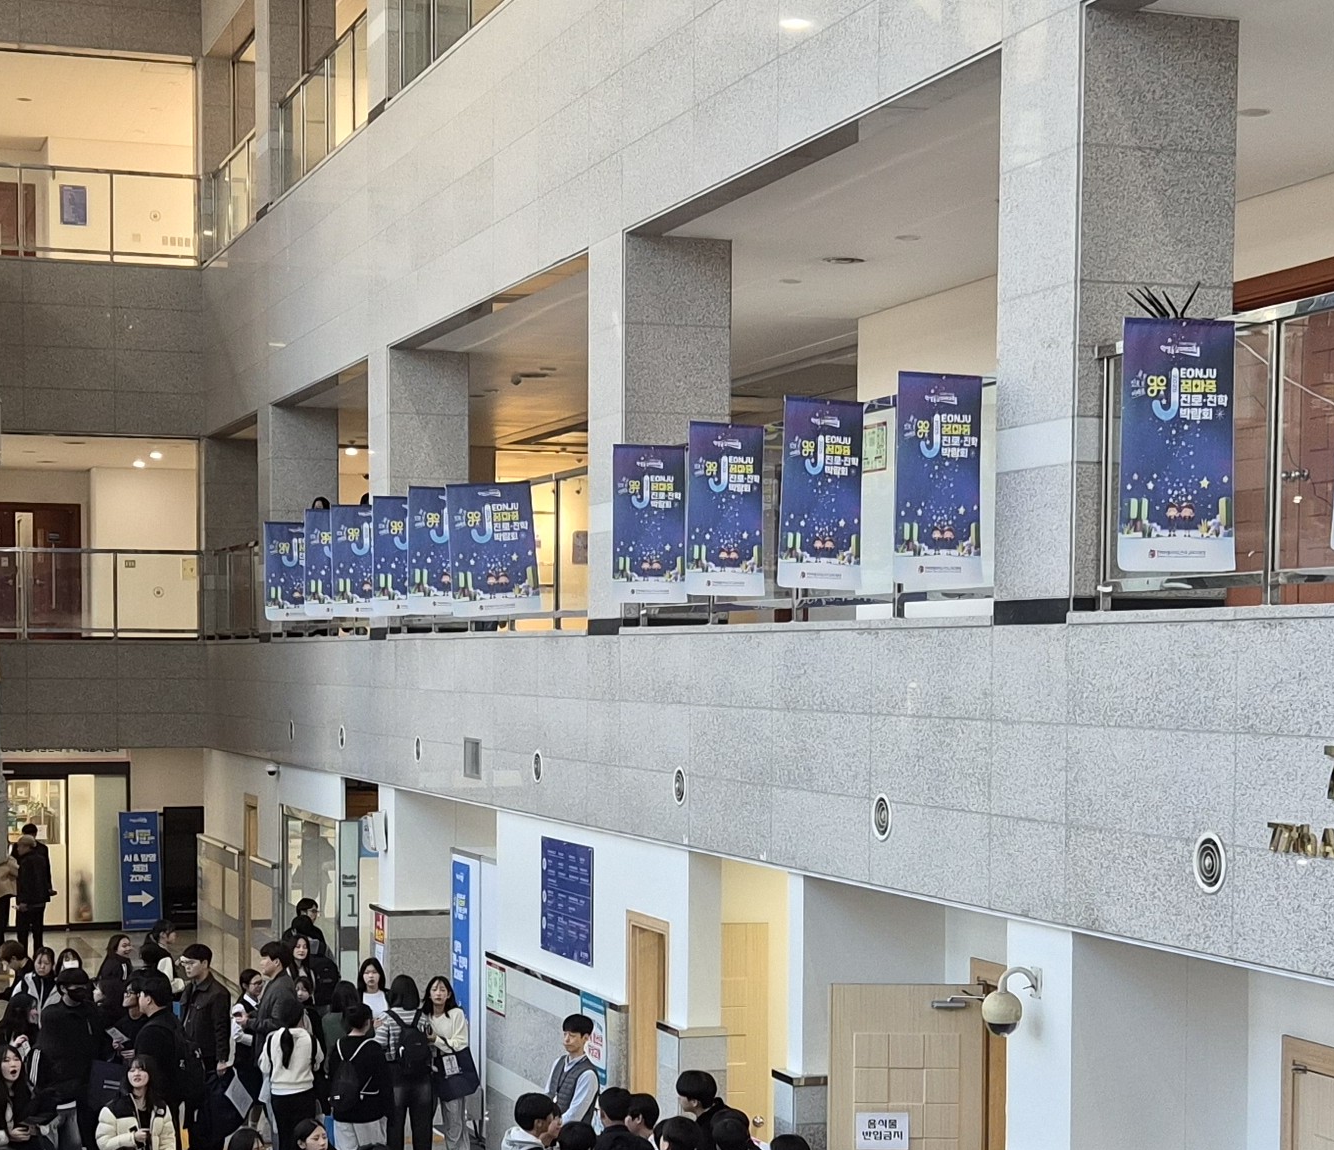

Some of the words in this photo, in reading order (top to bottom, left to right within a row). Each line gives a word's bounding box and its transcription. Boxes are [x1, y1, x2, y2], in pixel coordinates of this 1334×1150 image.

[1179, 379, 1217, 394] 꿈마중
[1179, 407, 1213, 421] 박람회
[123, 853, 133, 863] AI
[129, 874, 153, 882] ZONE
[347, 894, 357, 918] 1
[867, 1118, 898, 1129] 음식물
[861, 1130, 903, 1141] 반입금지
